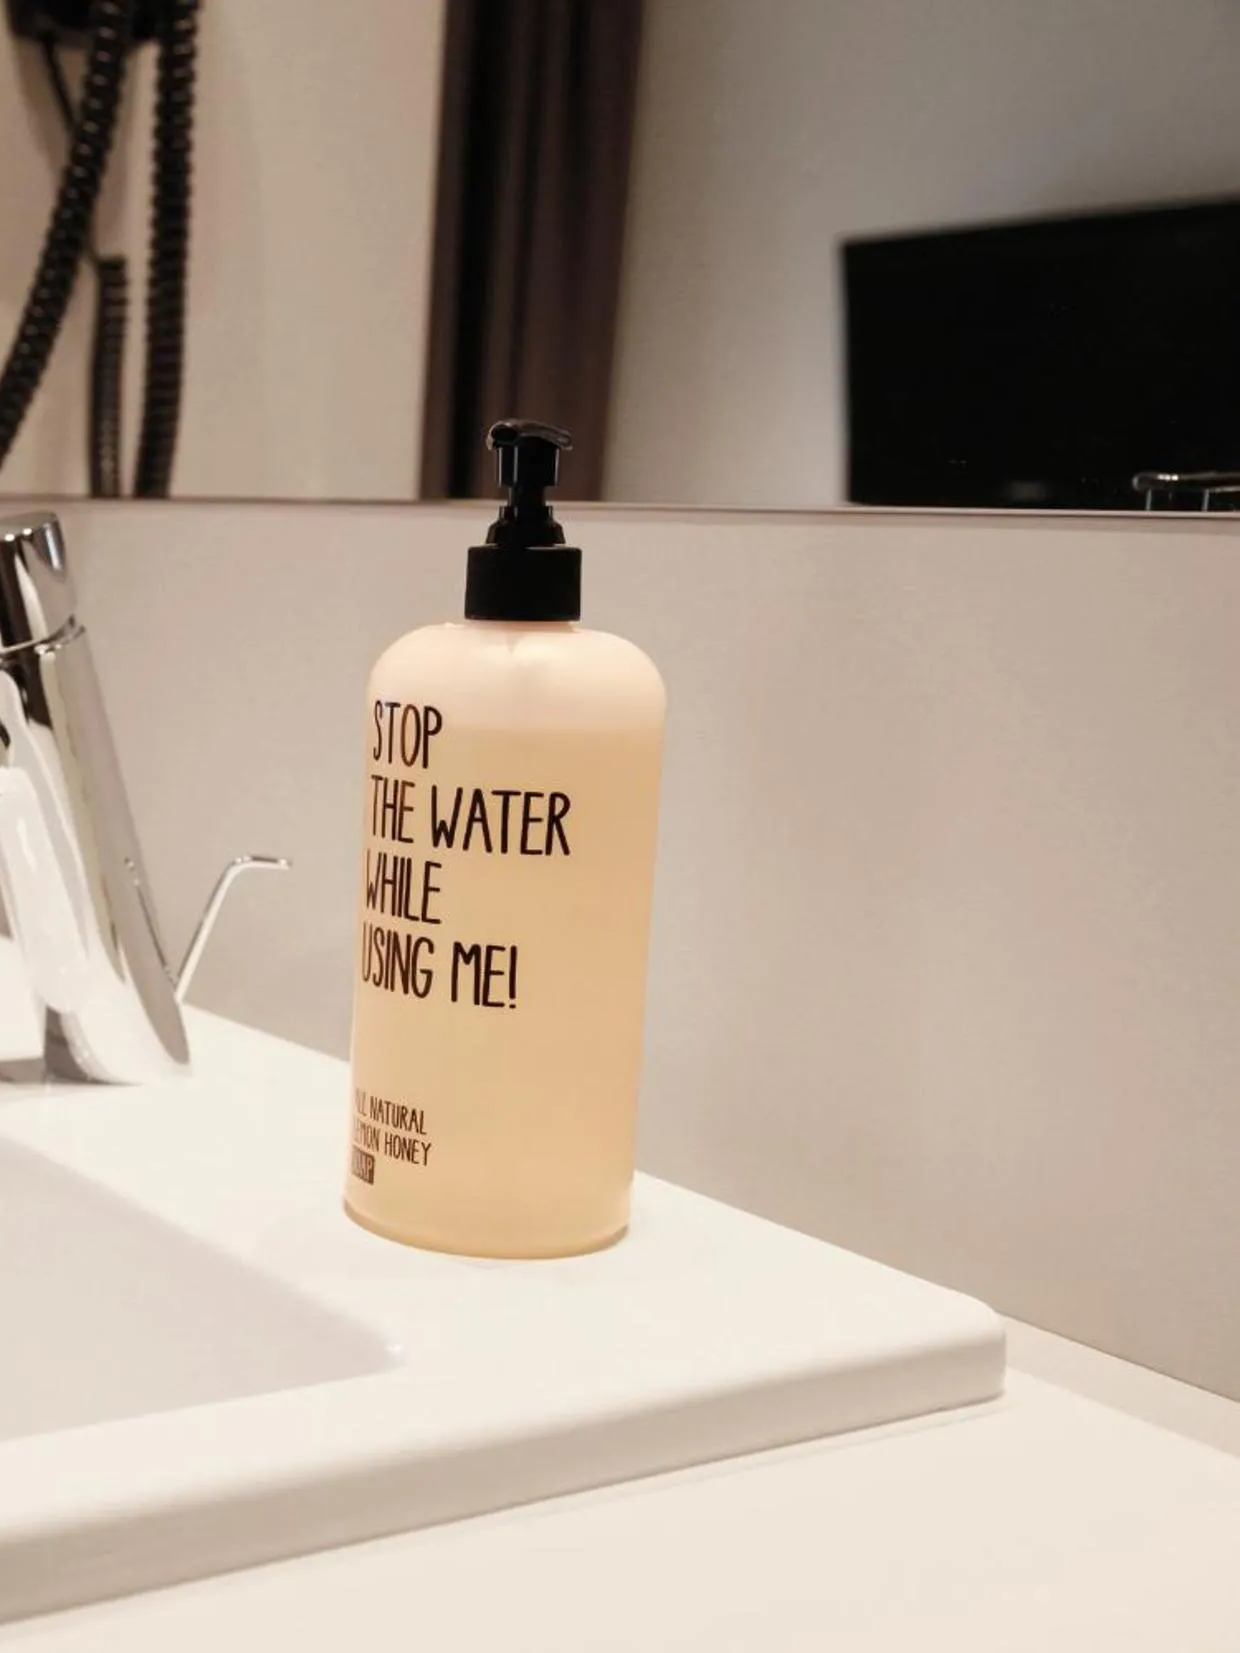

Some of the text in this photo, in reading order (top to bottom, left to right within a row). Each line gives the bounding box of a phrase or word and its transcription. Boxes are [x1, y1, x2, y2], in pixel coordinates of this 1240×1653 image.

[372, 699, 443, 769] STOP
[370, 774, 571, 856] THE WATER
[366, 848, 443, 925] WHILE
[361, 920, 519, 1010] USING ME!
[369, 1095, 428, 1135] NATURAL
[384, 1131, 432, 1167] HONEY
[351, 1147, 374, 1184] AP
